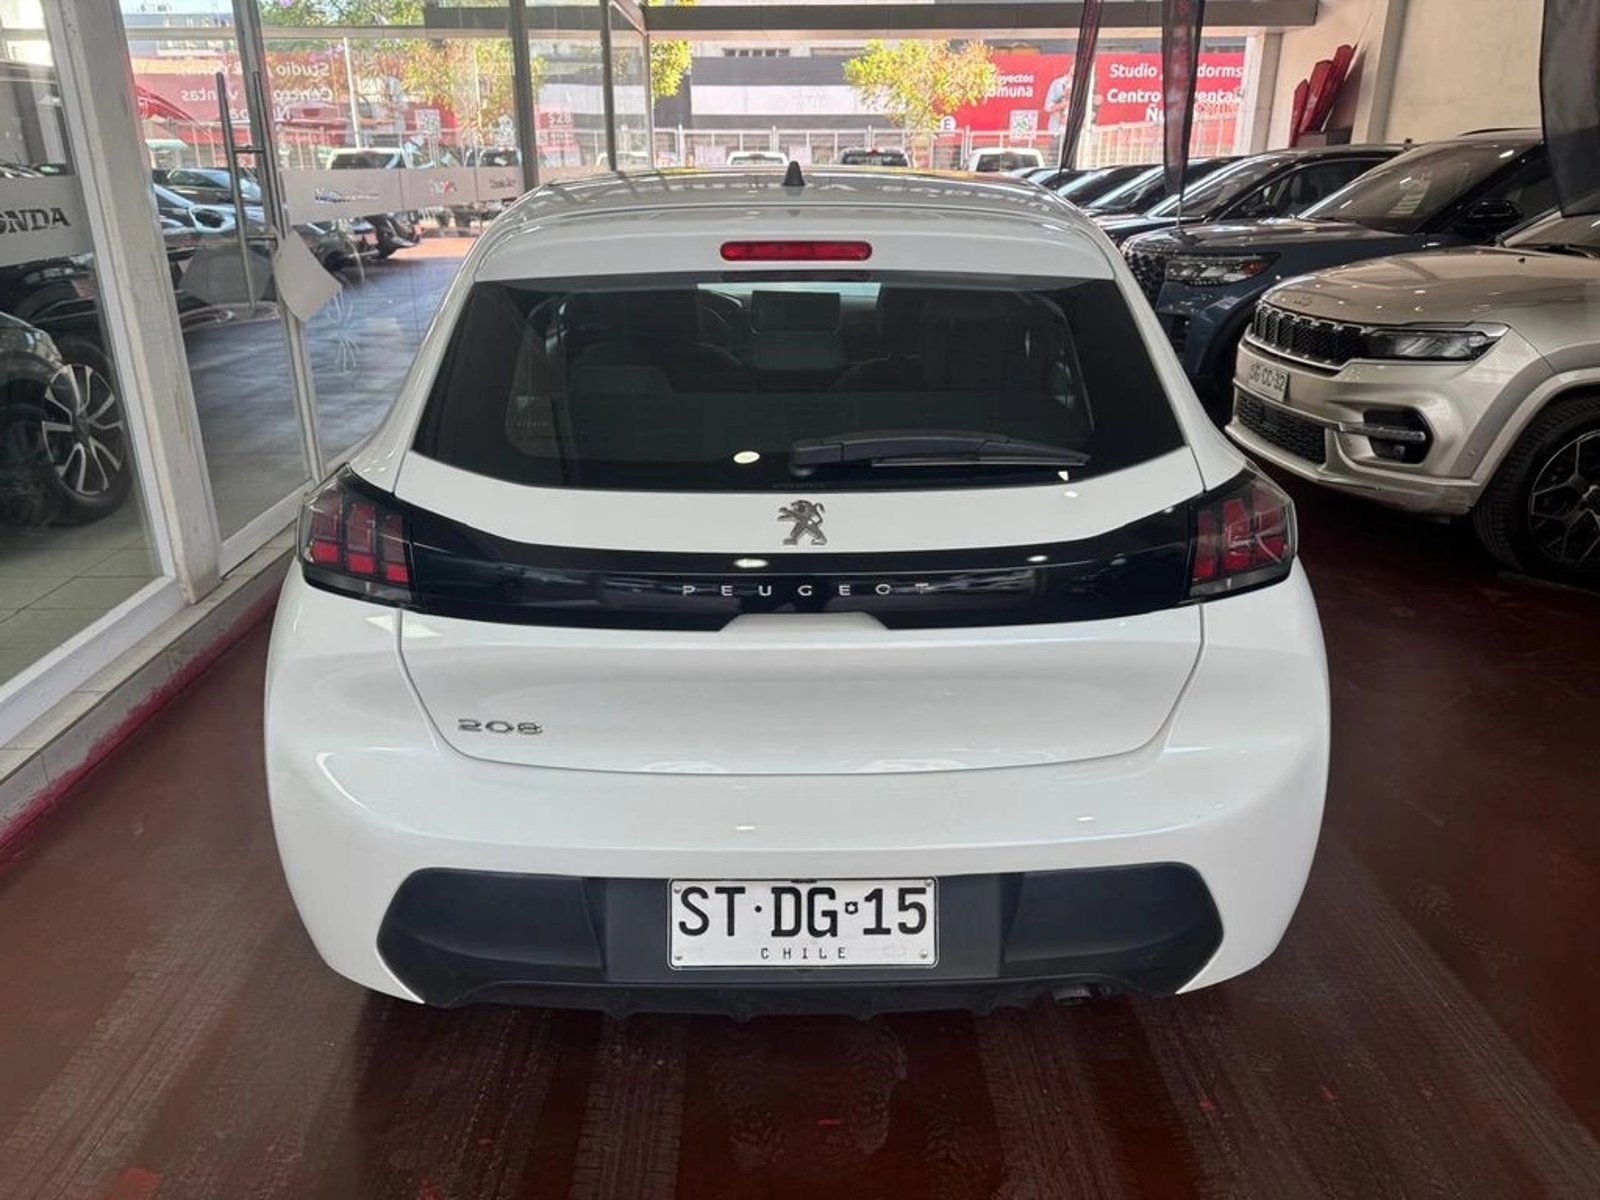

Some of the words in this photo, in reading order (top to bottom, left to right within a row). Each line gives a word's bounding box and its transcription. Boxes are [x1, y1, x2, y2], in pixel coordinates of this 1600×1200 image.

[1109, 63, 1157, 78] Studio
[1196, 63, 1244, 78] dorms
[1107, 88, 1162, 103] Centro
[682, 582, 929, 597] PEUGEOT
[458, 719, 543, 735] 208
[760, 947, 846, 960] CHILE
